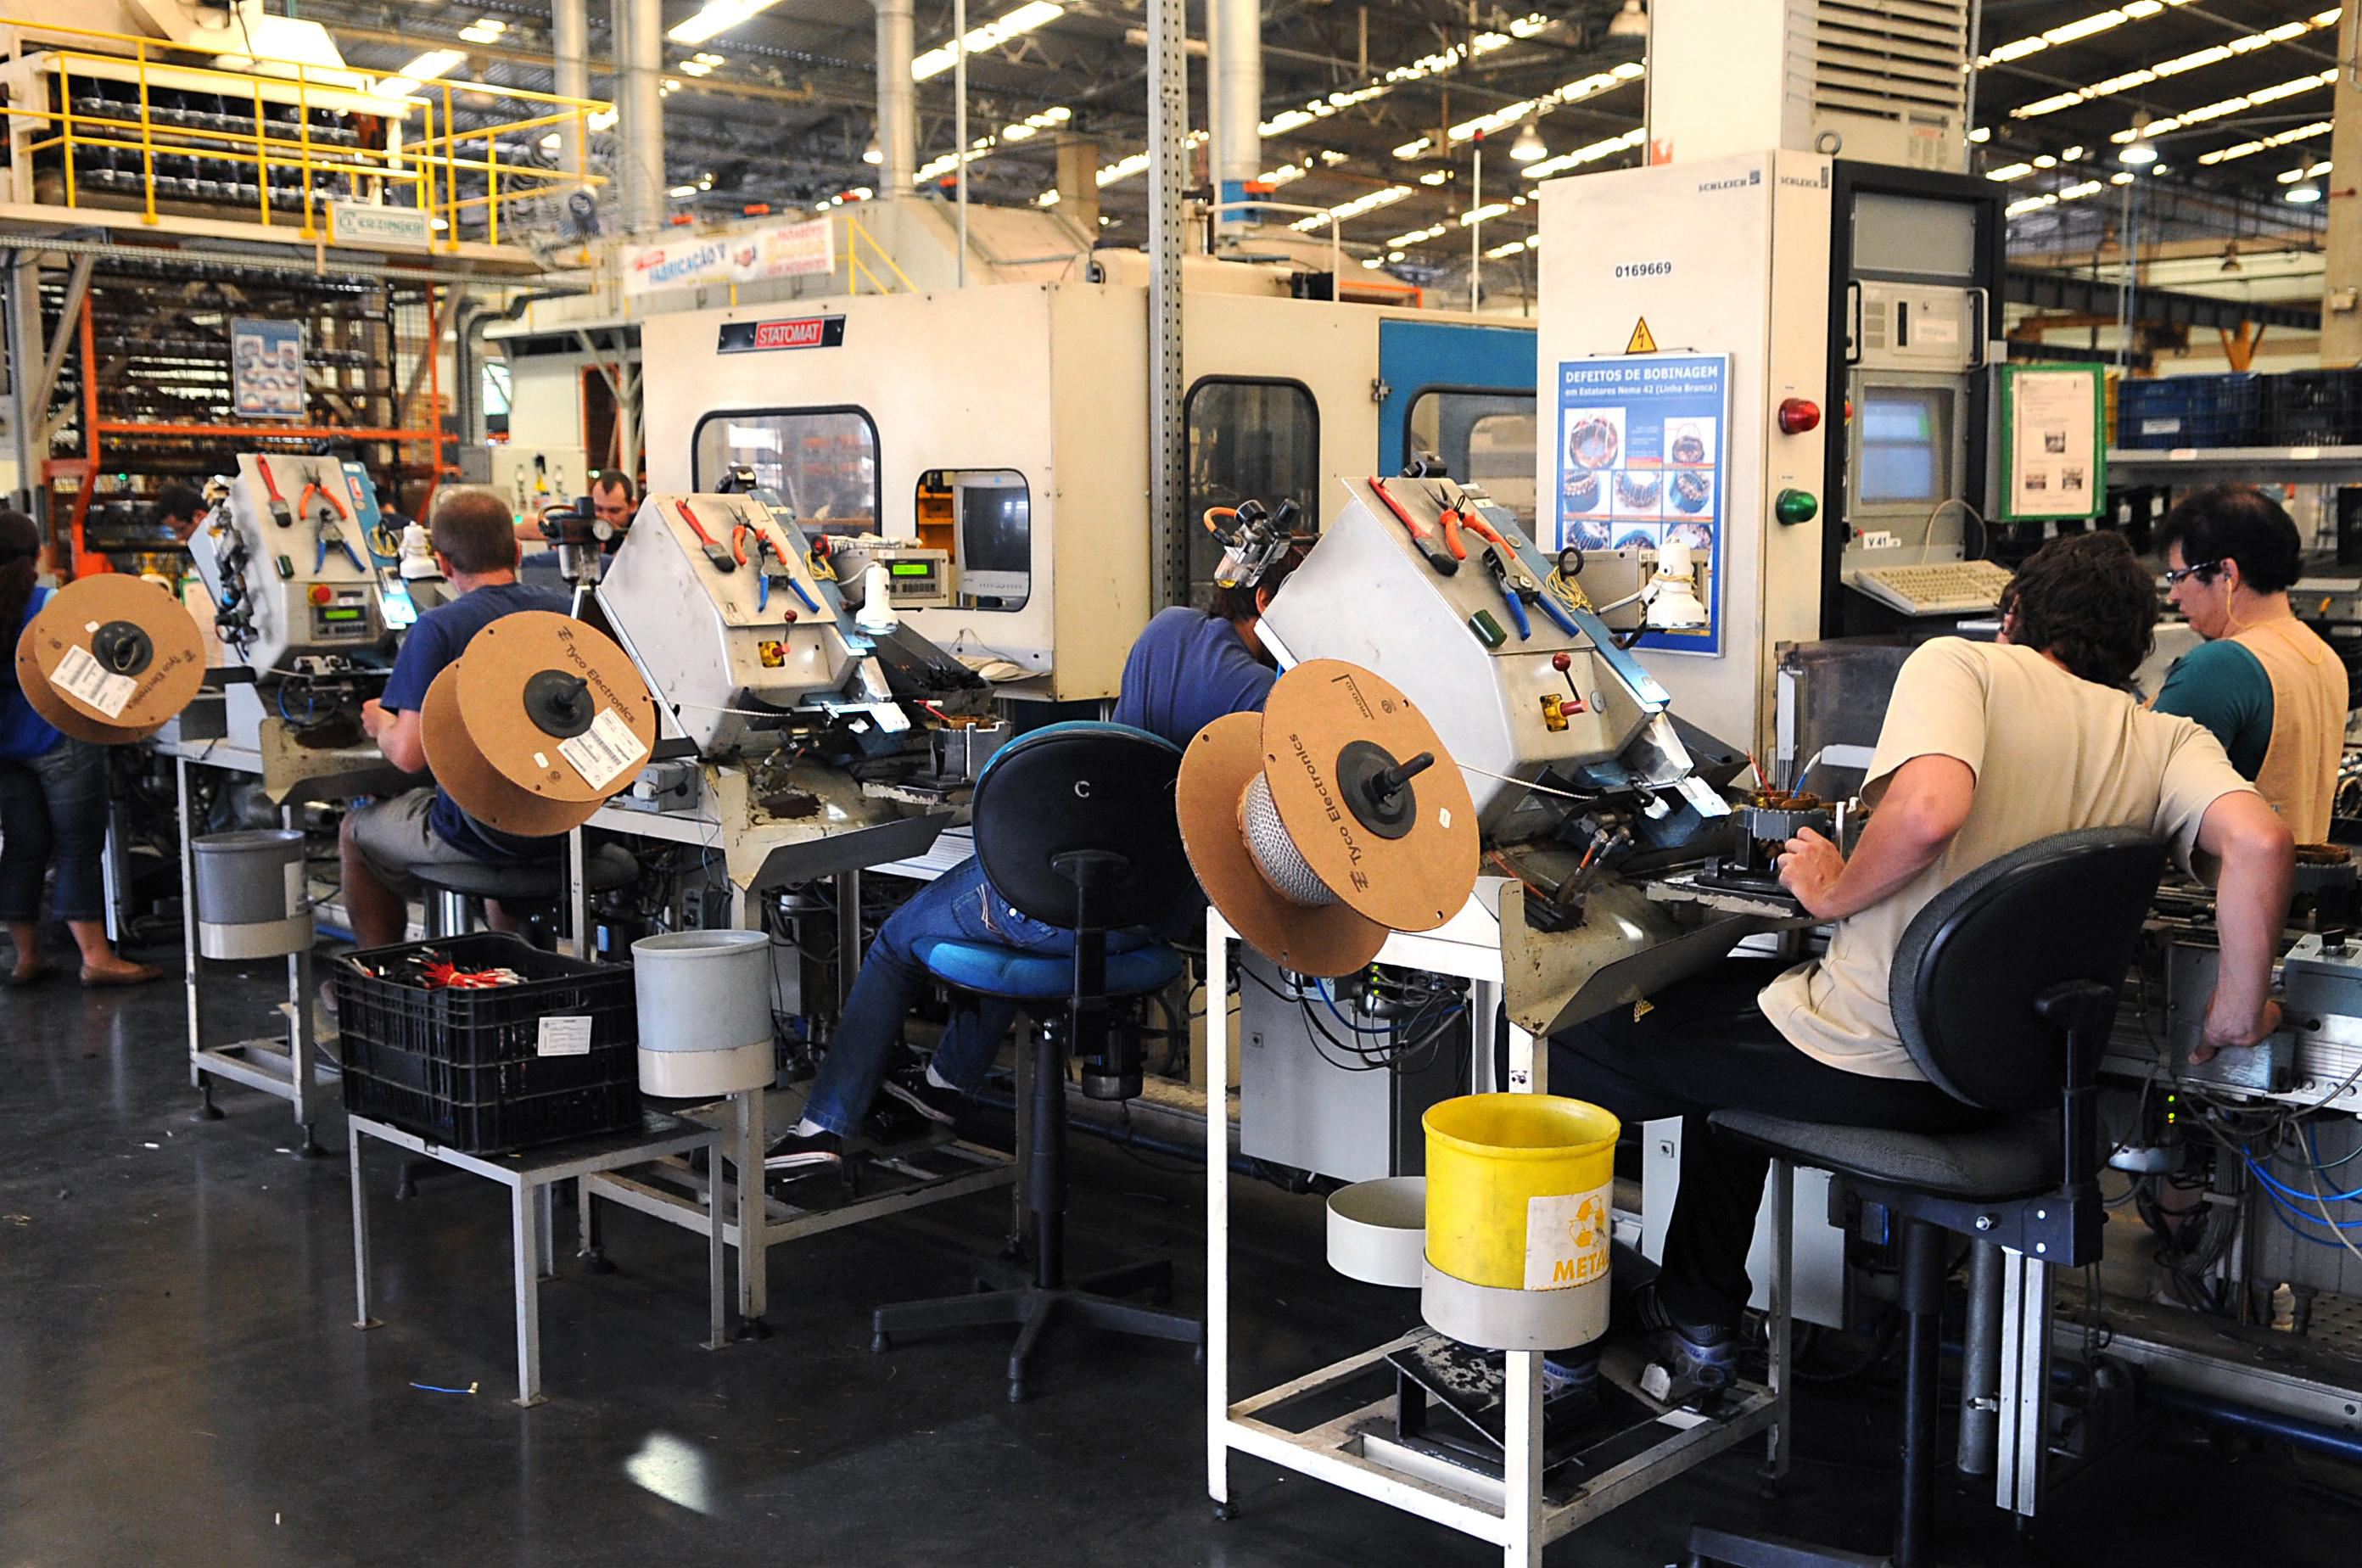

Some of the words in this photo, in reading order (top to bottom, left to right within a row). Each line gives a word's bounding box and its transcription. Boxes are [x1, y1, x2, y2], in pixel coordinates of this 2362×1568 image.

[1615, 261, 1671, 278] 0169669
[758, 323, 820, 344] STATOMAT
[1565, 370, 1622, 384] DEFEITOS
[1625, 368, 1641, 381] DE
[1643, 366, 1719, 380] BOBINAGEM
[1579, 387, 1616, 396] Estatores
[1643, 385, 1654, 395] 42
[1655, 384, 1682, 395] (Linha
[1684, 384, 1718, 395] Branca)
[1868, 537, 1875, 547] V
[1877, 536, 1887, 546] 41
[566, 644, 587, 669] Tyco
[587, 669, 635, 723] Electronics
[1352, 692, 1369, 719] PROD
[1289, 733, 1341, 823] Electronics
[1074, 781, 1090, 798] C
[1341, 826, 1362, 866] Tyco
